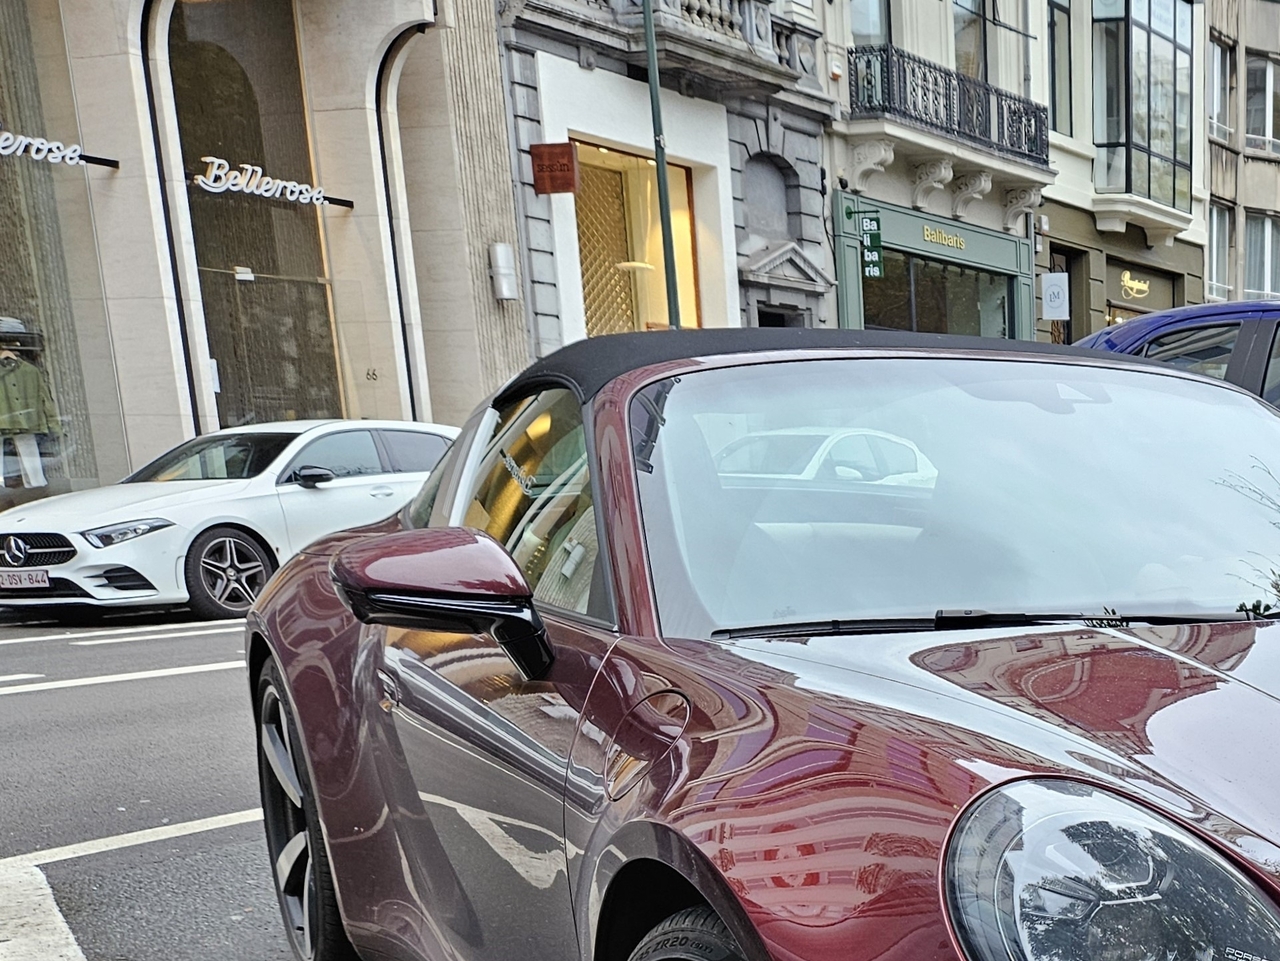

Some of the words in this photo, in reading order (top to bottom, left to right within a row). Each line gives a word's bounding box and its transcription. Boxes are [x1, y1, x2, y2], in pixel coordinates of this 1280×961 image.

[862, 218, 878, 231] Ba
[922, 224, 966, 250] Balibaris
[863, 248, 879, 262] ba
[864, 263, 880, 277] ris
[366, 368, 378, 381] 66
